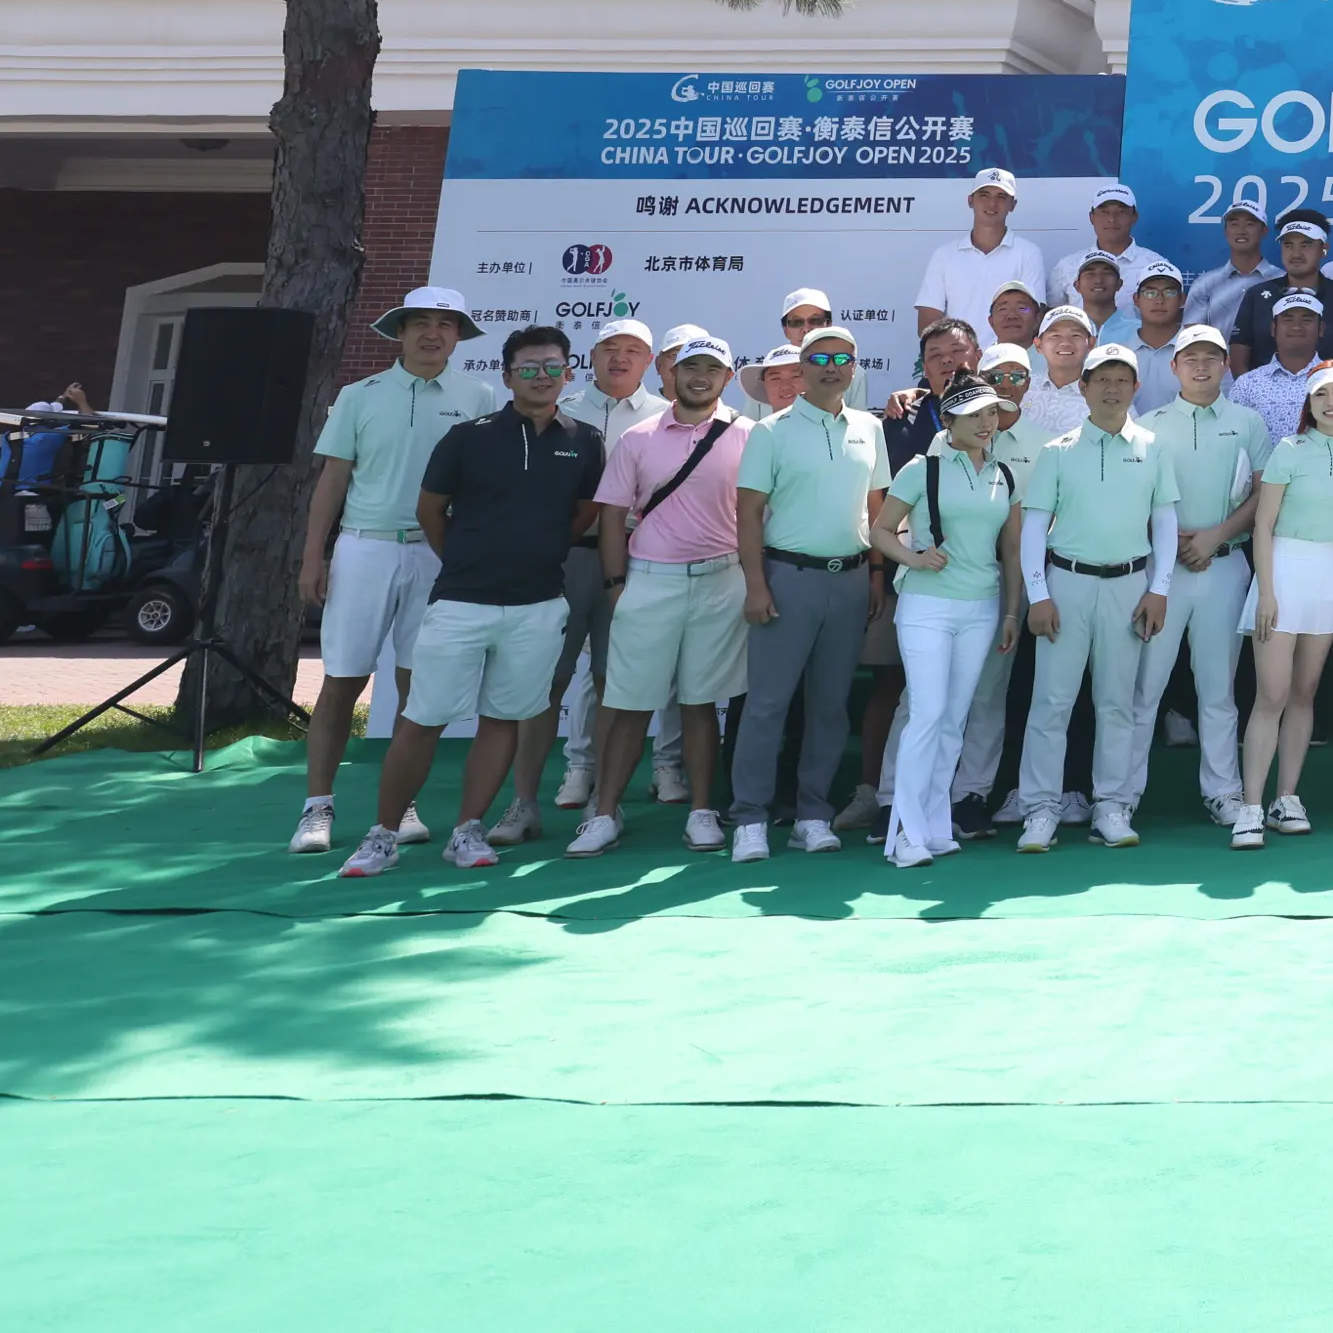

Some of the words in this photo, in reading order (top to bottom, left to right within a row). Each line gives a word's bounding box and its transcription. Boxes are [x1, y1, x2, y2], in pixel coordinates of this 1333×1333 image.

[707, 81, 775, 94] 中国巡回赛
[825, 79, 880, 90] GOLFJOY
[883, 79, 916, 90] OPEN
[601, 146, 669, 165] CHINA
[855, 146, 916, 164] OPEN
[919, 146, 971, 164] 2025
[636, 195, 679, 216] 鸣谢
[685, 196, 915, 215] ACKNOWLEDGEMENT
[476, 262, 526, 274] 主办单位
[644, 256, 744, 272] 北京市体育局
[470, 309, 532, 322] 冠名赞助商
[556, 301, 641, 318] GOLFJOY
[841, 309, 888, 321] 认证单位
[463, 359, 503, 372] 承办单
